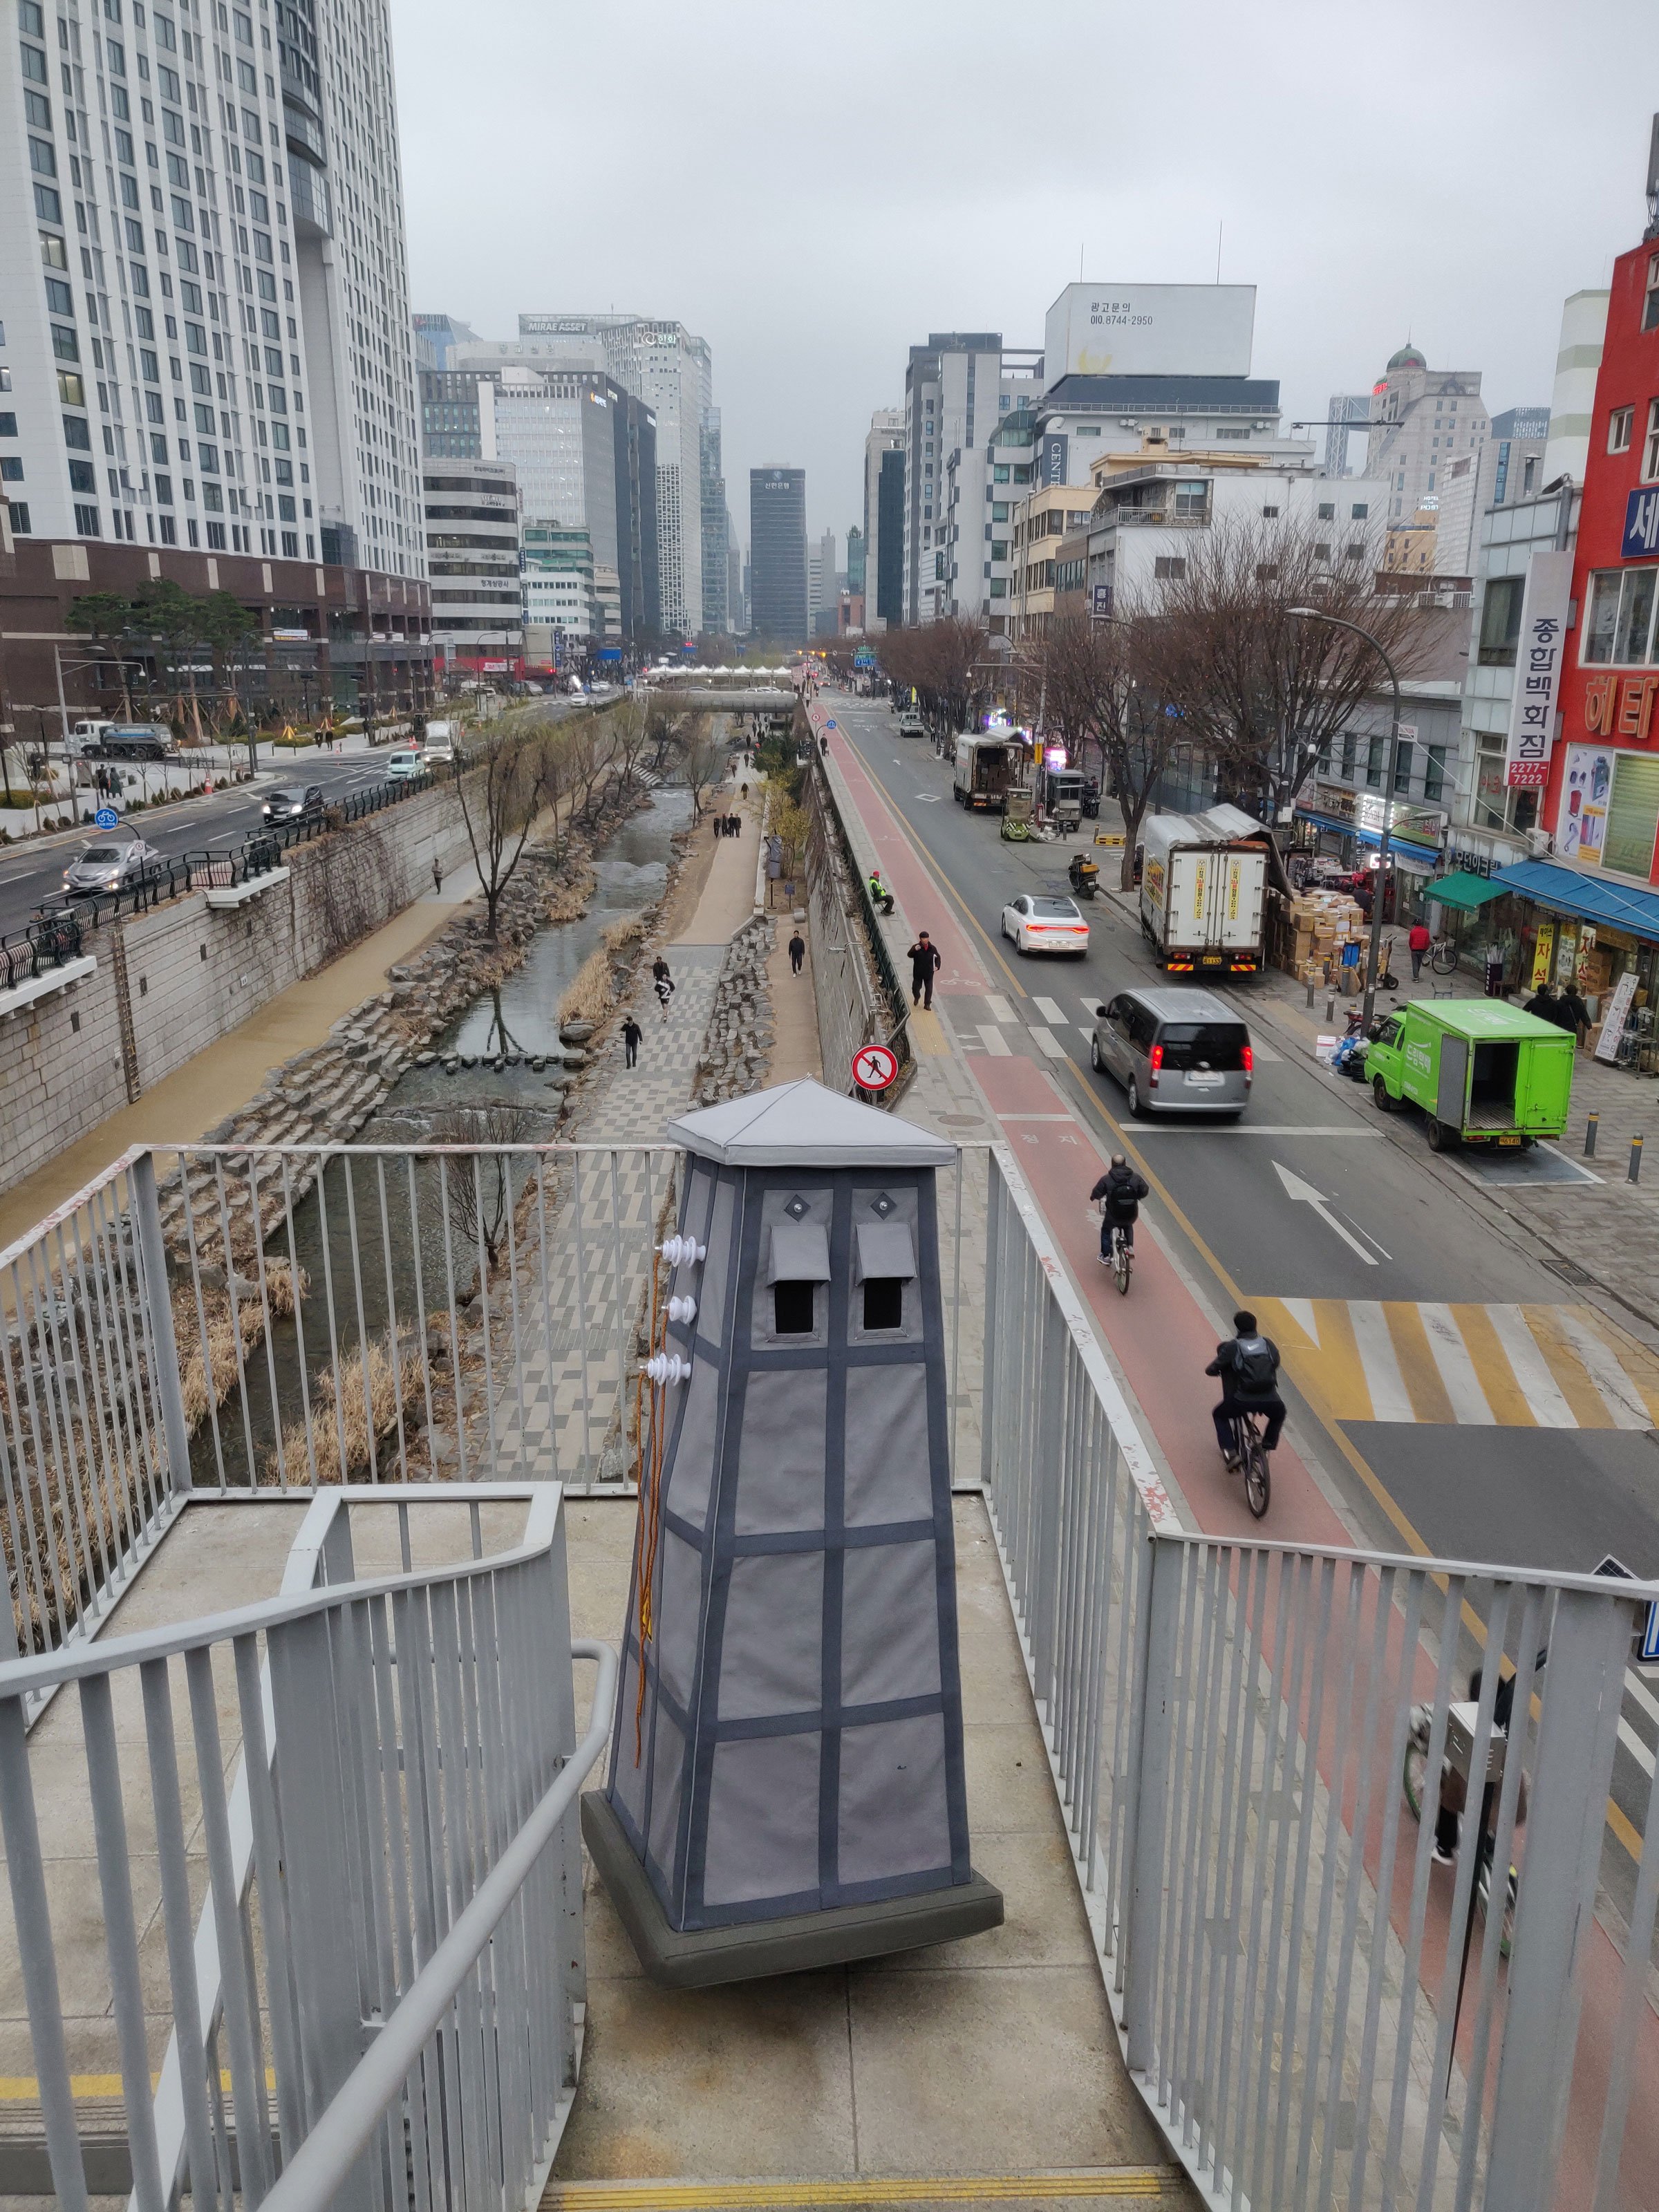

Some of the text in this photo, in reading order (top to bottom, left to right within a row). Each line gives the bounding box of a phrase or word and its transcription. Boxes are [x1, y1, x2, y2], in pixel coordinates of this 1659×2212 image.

[1091, 302, 1130, 313] 광고문의
[1090, 315, 1153, 326] 010.8744-2950
[528, 322, 587, 332] MIRAE ASSET
[658, 335, 676, 344] 한화
[1519, 619, 1559, 758] 종합백화점
[1511, 763, 1547, 773] 2277-
[1514, 774, 1542, 784] 7222
